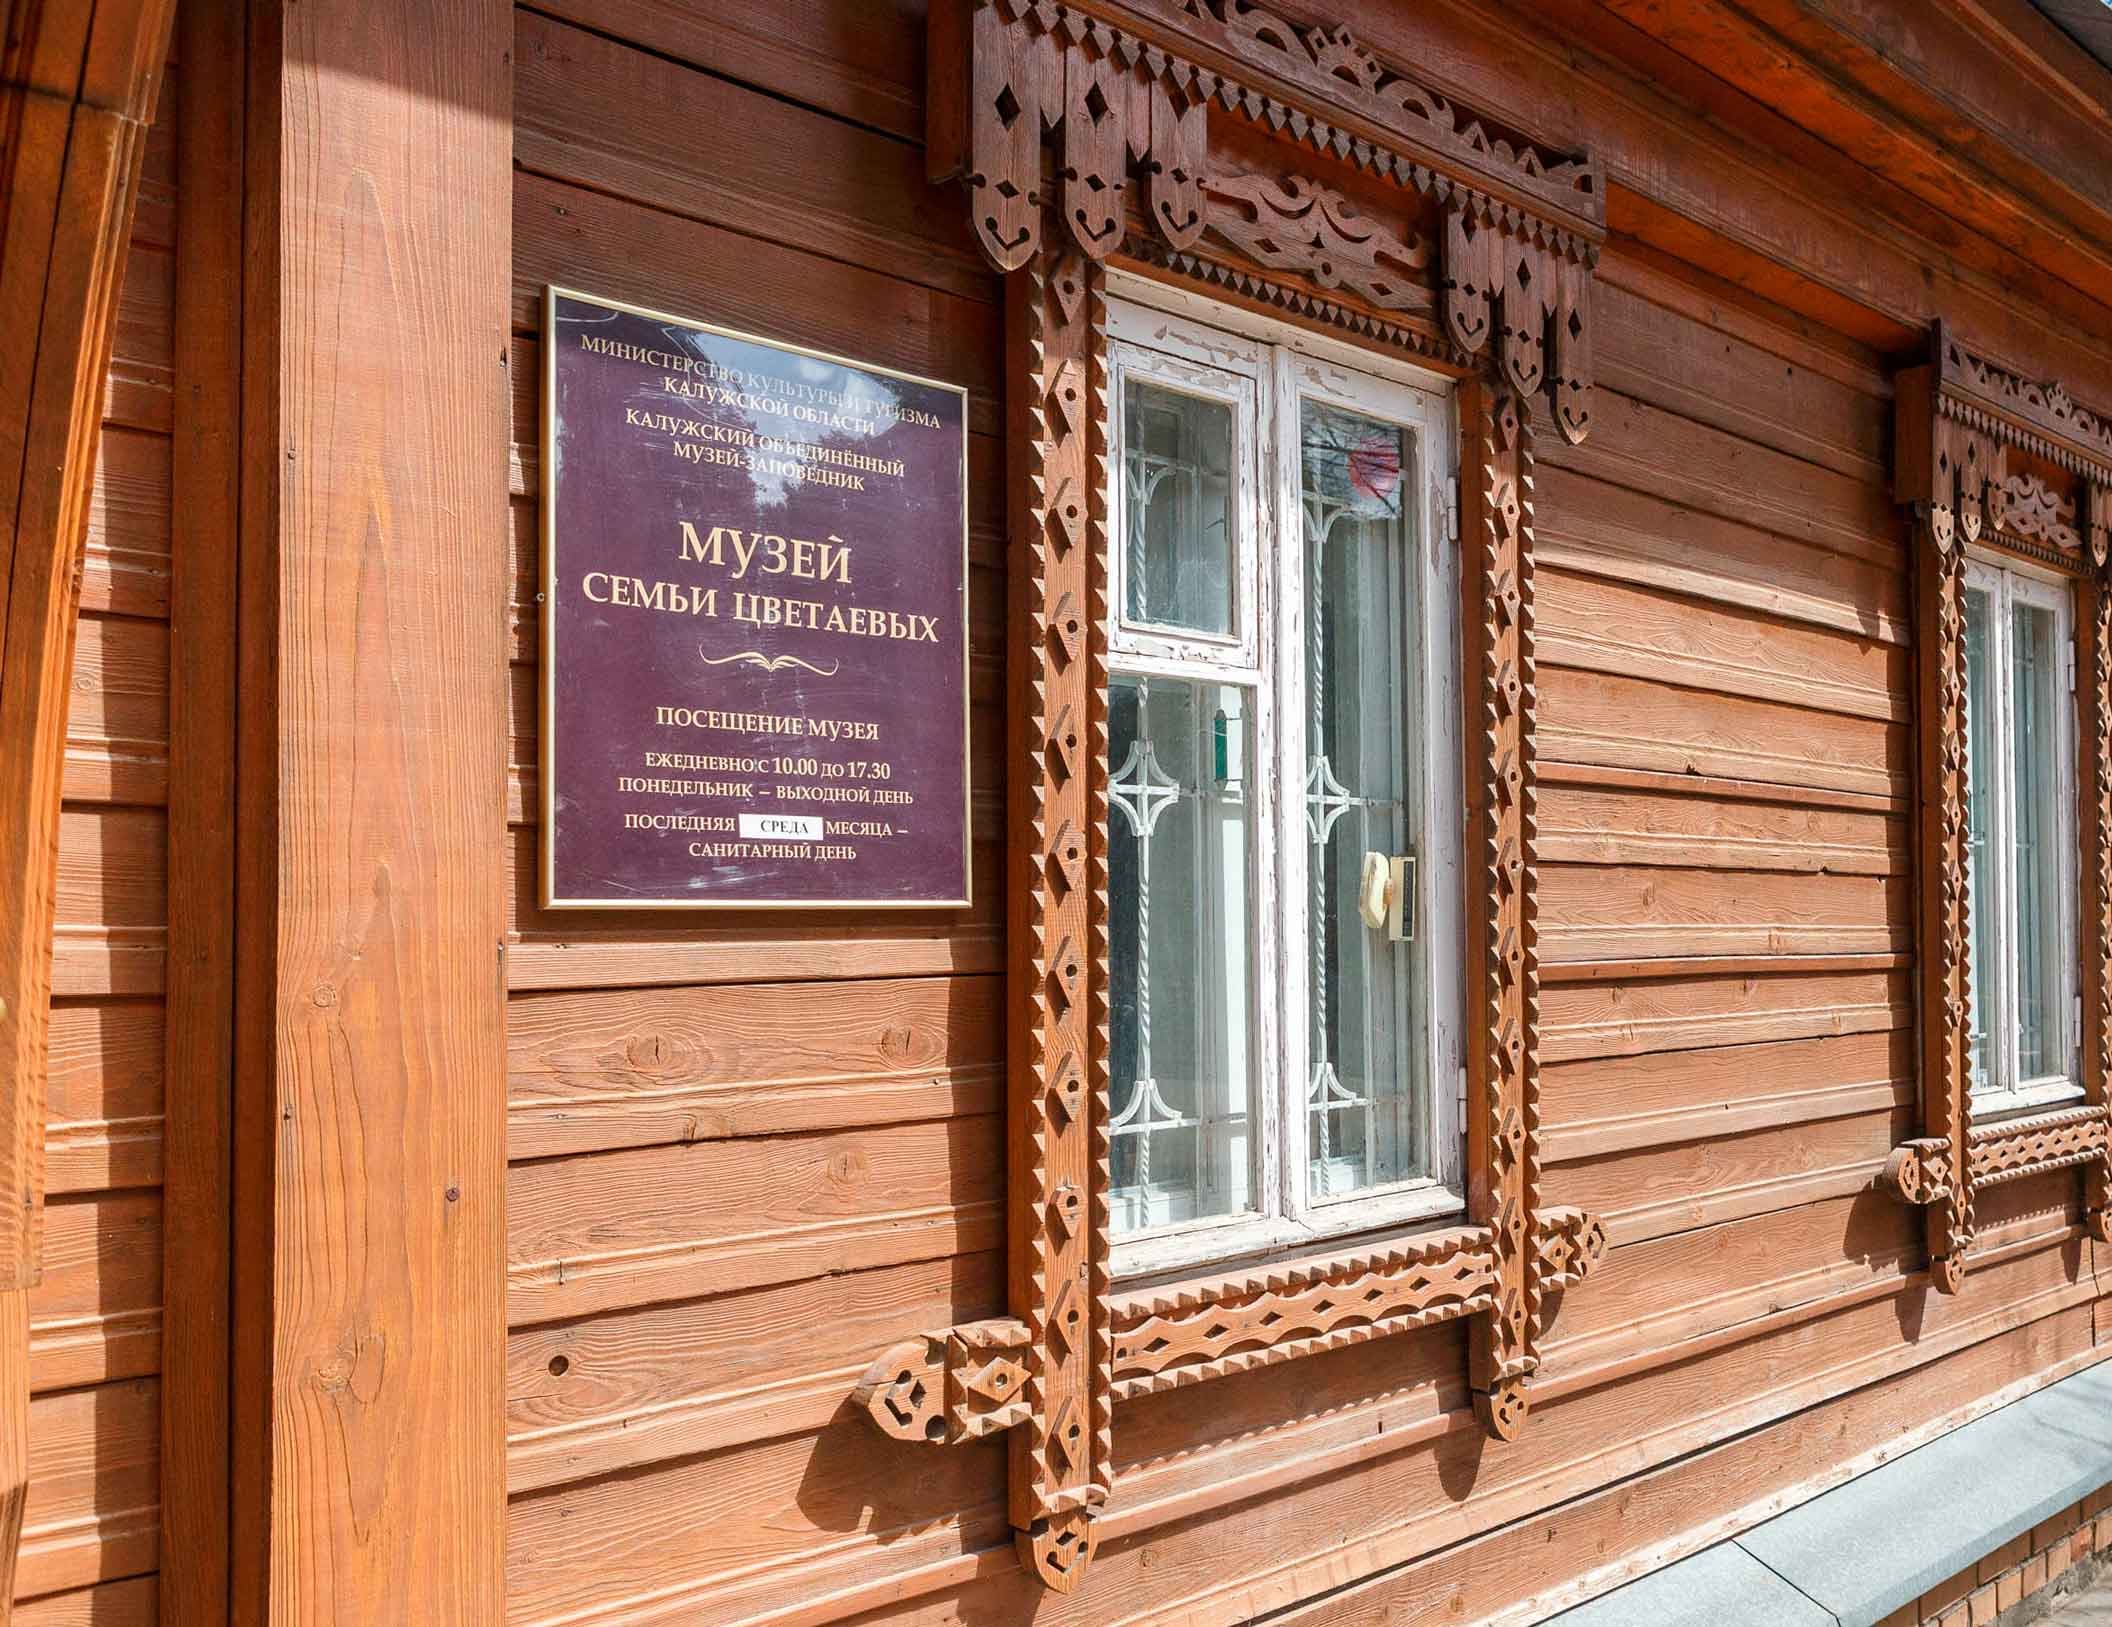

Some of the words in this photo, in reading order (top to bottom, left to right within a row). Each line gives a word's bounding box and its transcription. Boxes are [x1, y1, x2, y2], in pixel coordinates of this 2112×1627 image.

[580, 334, 744, 384] МИНИСТЕРСТВО
[748, 373, 844, 409] КУЛЬТУРЫ
[864, 398, 941, 430] ТУРИЗМА
[663, 376, 789, 417] КАЛУЖСКОЙ
[793, 405, 875, 435] ОБЛАСТИ
[625, 407, 754, 448] КАЛУЖСКИЙ
[759, 434, 905, 477] ОБЪЕДИНЁННЫЙ
[673, 441, 865, 491] МУЗЕЙ-ЗАПОВЕДНИК
[678, 521, 852, 583] МУЗЕЙ
[582, 572, 718, 617] СЕМЬИ
[733, 592, 940, 643] ЦВЕТАЕВЫХ
[655, 706, 804, 735] ПОСЕЩЕНИЕ
[807, 718, 880, 742] МУЗЕЯ
[645, 752, 754, 772] ЕЖЕДНЕВНО
[758, 759, 769, 773] С
[772, 757, 818, 776] 10.00
[821, 763, 845, 780] ДО
[847, 761, 891, 780] 17.30
[618, 777, 753, 798] ПОНЕДЕЛЬНИК
[776, 785, 870, 803] ВЫХОДНОЙ
[873, 789, 914, 806] ДЕНЬ
[624, 813, 736, 832] ПОСЛЕДНЯЯ
[760, 819, 809, 834] СРЕДА
[825, 820, 892, 838] МЕСЯЦА
[688, 841, 811, 860] САНИТАРНЫЙ
[814, 845, 857, 862] ДЕНЬ
